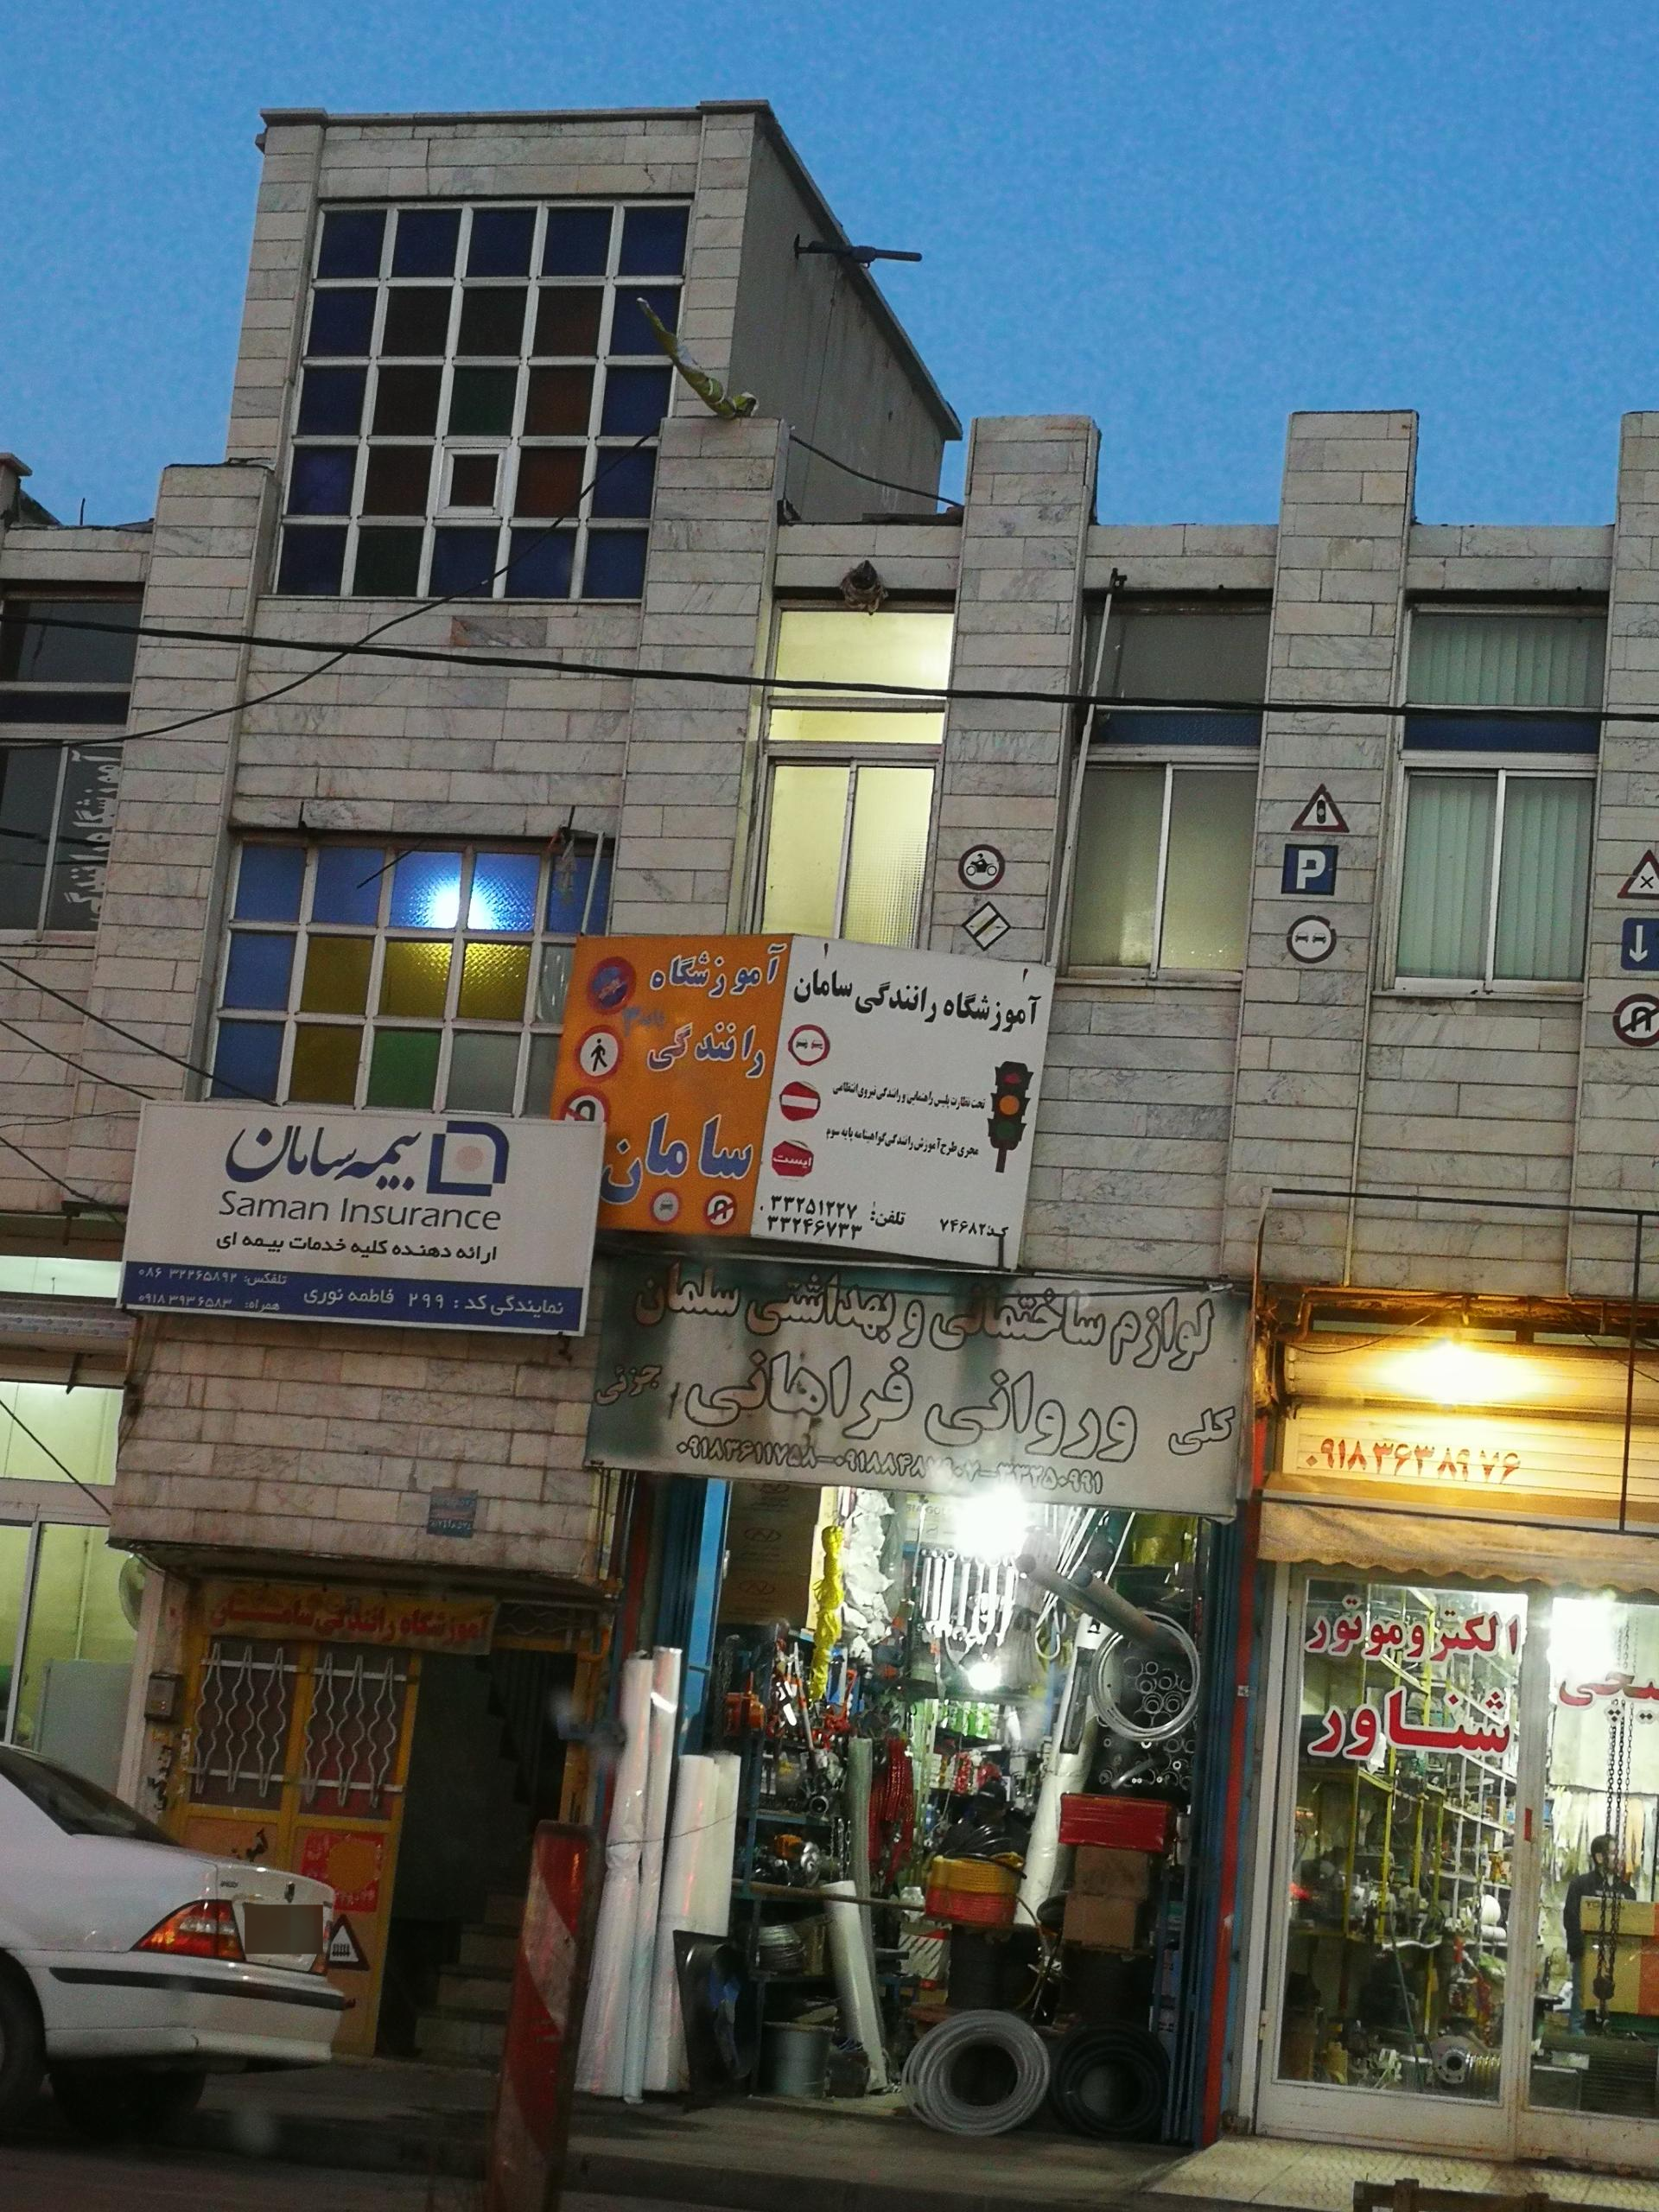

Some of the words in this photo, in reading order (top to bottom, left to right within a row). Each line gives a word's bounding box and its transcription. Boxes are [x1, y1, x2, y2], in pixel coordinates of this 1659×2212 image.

[1296, 849, 1325, 889] P
[650, 943, 787, 998] آموزشگاه
[794, 969, 852, 1003] سامان
[855, 982, 937, 1022] رانندگی
[944, 991, 1041, 1033] آموزشگاه
[647, 1020, 766, 1078] رانندگی
[876, 1086, 901, 1103] رانندگی
[826, 1128, 841, 1141] سوم
[885, 1133, 913, 1150] رانندگی
[913, 1137, 941, 1153] آموزش
[226, 1125, 357, 1183] سامان
[334, 1131, 422, 1191] بیمه
[601, 1112, 753, 1205] سامان
[219, 1190, 328, 1222] Saman
[340, 1198, 501, 1230] Insurance
[771, 1194, 858, 1219] ۳۳۲۵۱۲۲۷
[216, 1231, 238, 1249] ای
[242, 1233, 285, 1253] بیمه
[767, 1215, 862, 1241] ۳۳۲۴۶۷۳۳
[289, 1236, 346, 1253] خدمات
[351, 1240, 389, 1258] کلیه
[391, 1243, 451, 1259] دهنده
[457, 1245, 497, 1264] ارائه
[303, 1287, 343, 1306] نوری
[347, 1287, 394, 1304] فاطمه
[409, 1293, 444, 1309] ۲۹۹
[490, 1294, 564, 1318] نمایندگی
[744, 1273, 896, 1344] بهداشتی
[897, 1299, 925, 1348] و
[1109, 1297, 1215, 1371] لوازم
[685, 1349, 913, 1440] فراهانی
[1168, 1407, 1236, 1456] کلی
[1309, 1687, 1511, 1758] شناور
